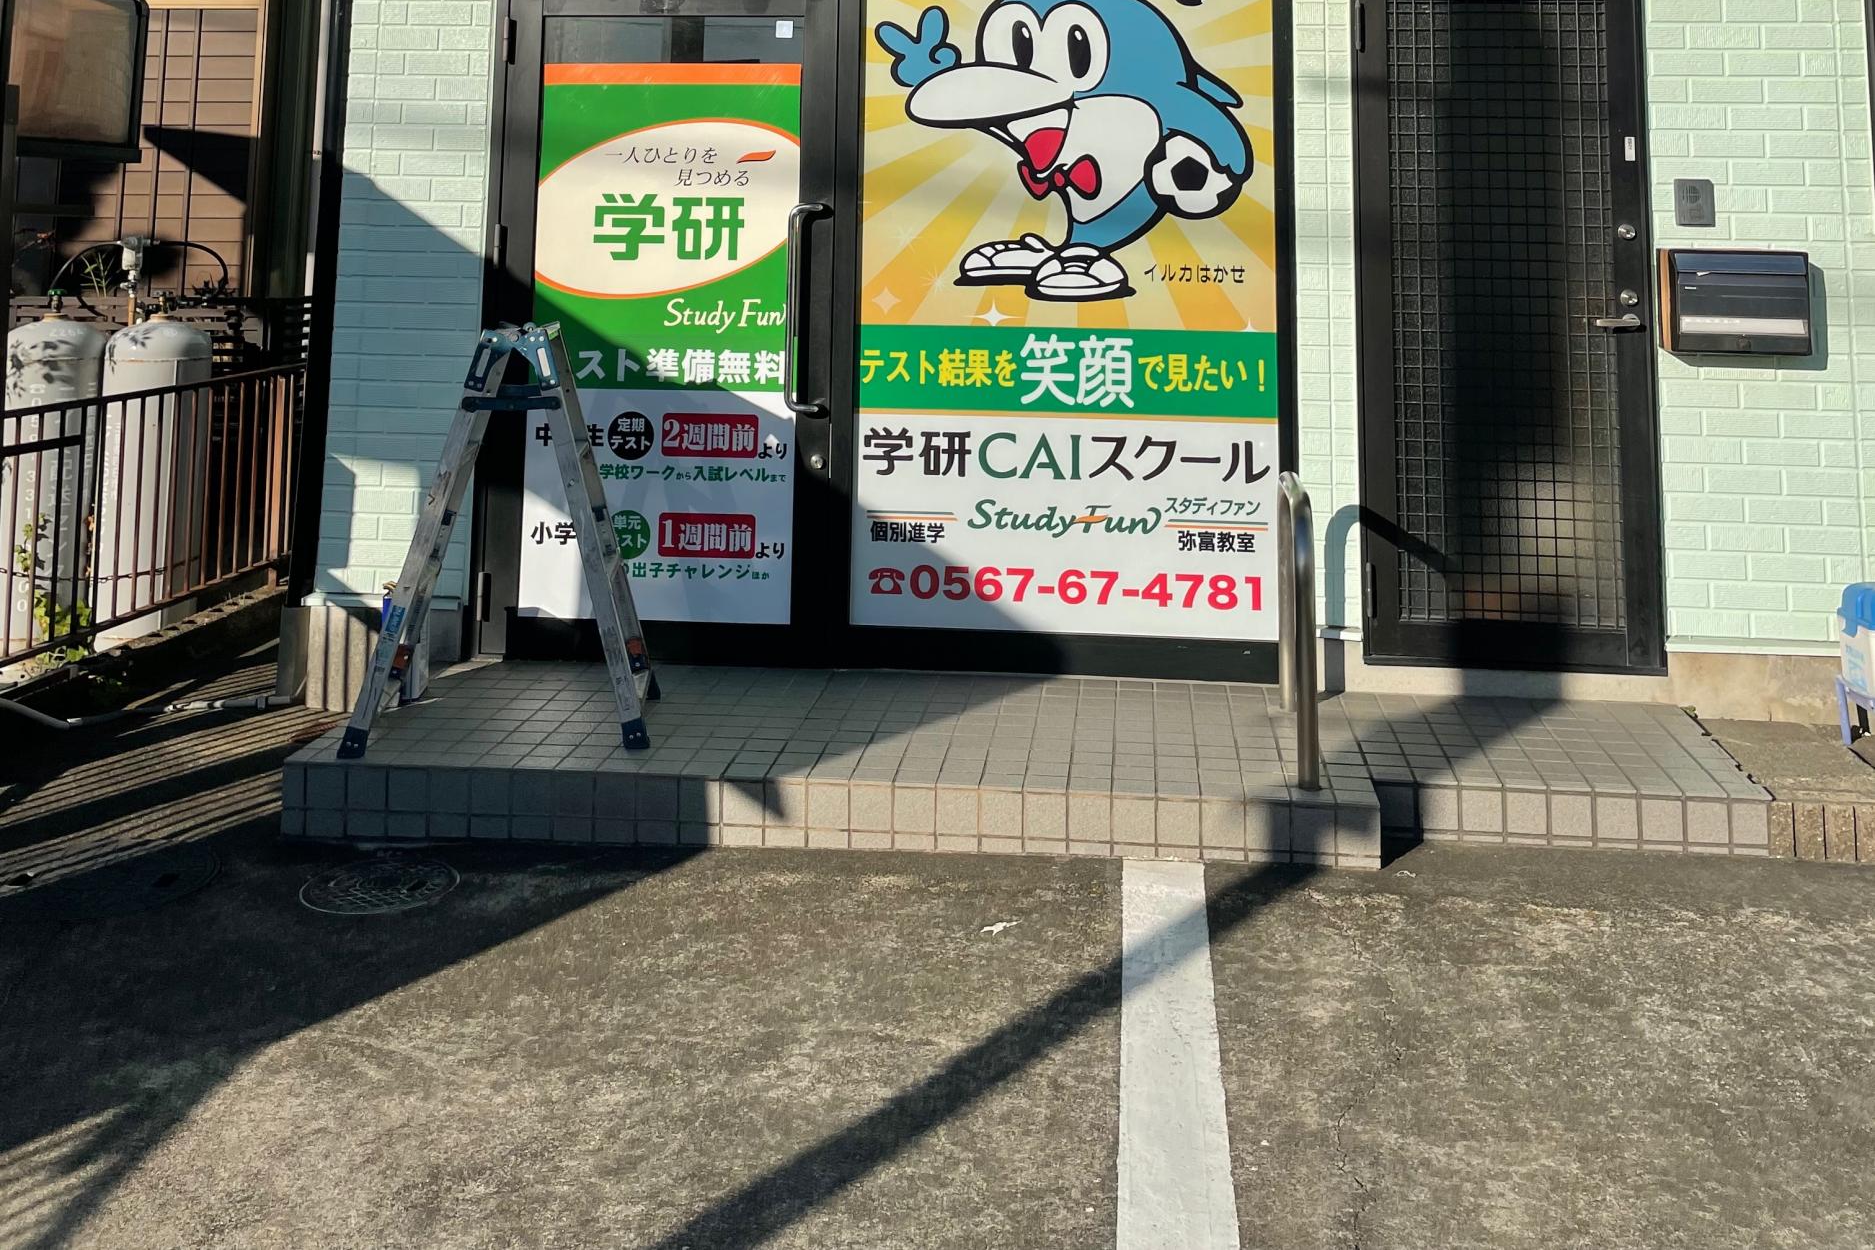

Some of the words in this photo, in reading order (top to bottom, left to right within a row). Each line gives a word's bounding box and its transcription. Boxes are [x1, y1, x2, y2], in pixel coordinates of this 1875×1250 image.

[604, 146, 718, 165] 一人ひとりを
[675, 169, 751, 187] 見つめる
[593, 193, 745, 261] 学研
[1143, 263, 1246, 285] イルカはかせ
[575, 347, 786, 386] スト準備無料
[617, 417, 646, 433] 定期
[662, 418, 756, 452] 2週間前
[610, 435, 652, 451] テスト
[862, 426, 1271, 484] 学研CAIスクール
[1164, 496, 1261, 517] スタディファン
[530, 521, 577, 546] 小学
[616, 533, 648, 549] スト
[661, 519, 753, 553] 1週間前
[869, 520, 945, 544] 個別進学
[1177, 530, 1257, 554] 弥富教室
[909, 563, 1263, 611] 0567-67-4781
